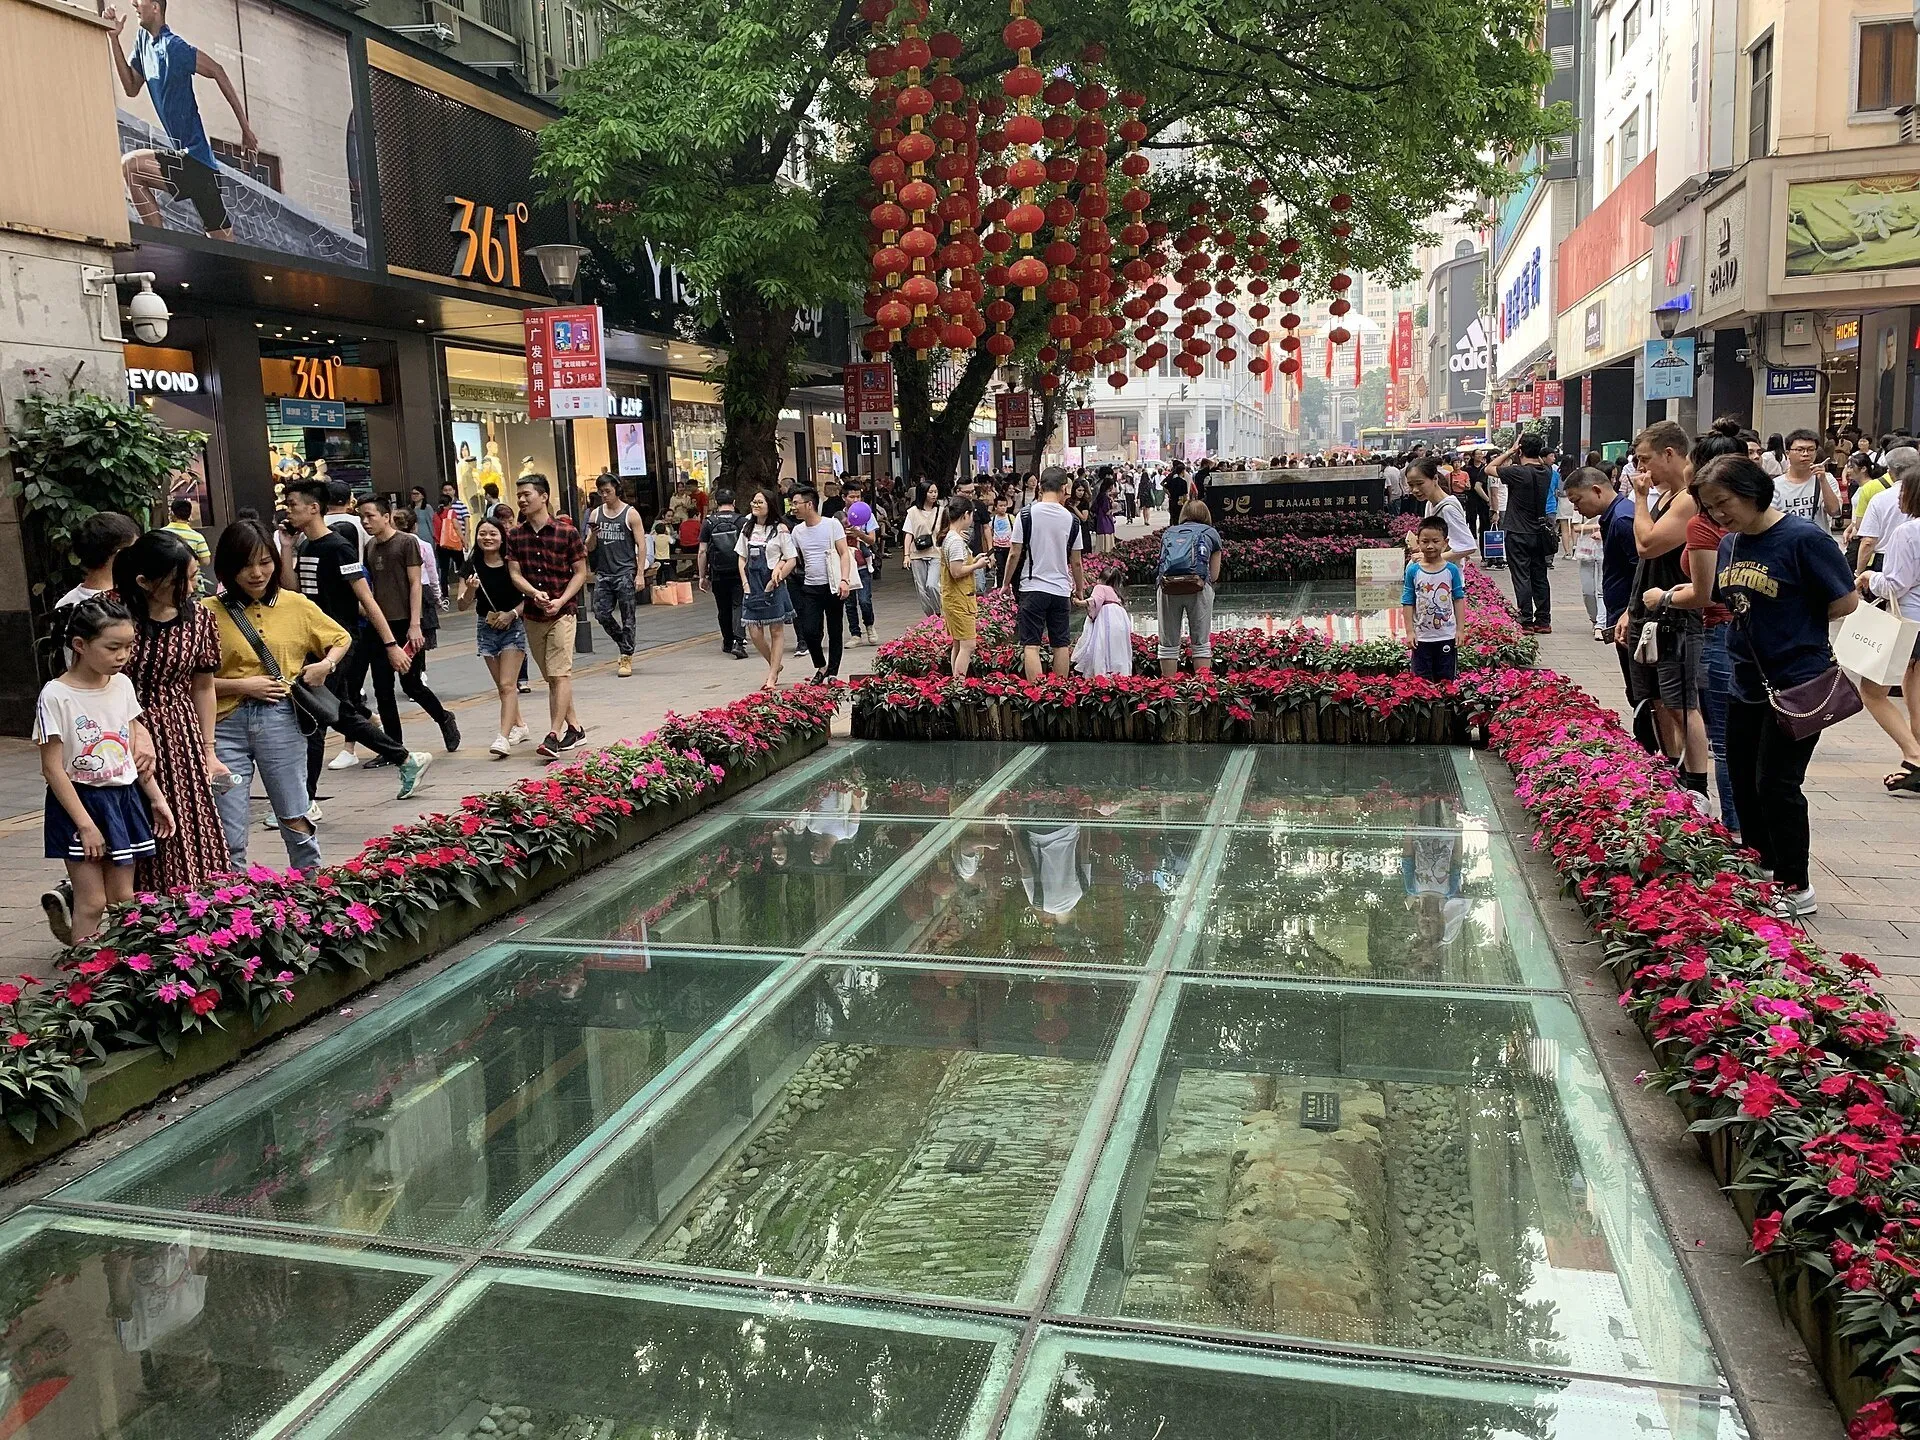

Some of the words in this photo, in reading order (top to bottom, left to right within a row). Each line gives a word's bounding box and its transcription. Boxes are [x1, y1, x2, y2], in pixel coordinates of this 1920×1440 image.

[449, 195, 528, 288] 361°
[293, 355, 341, 399] 361°
[529, 327, 546, 409] 广发信用卡
[1449, 345, 1491, 373] adid
[1851, 631, 1877, 649] ICICLE
